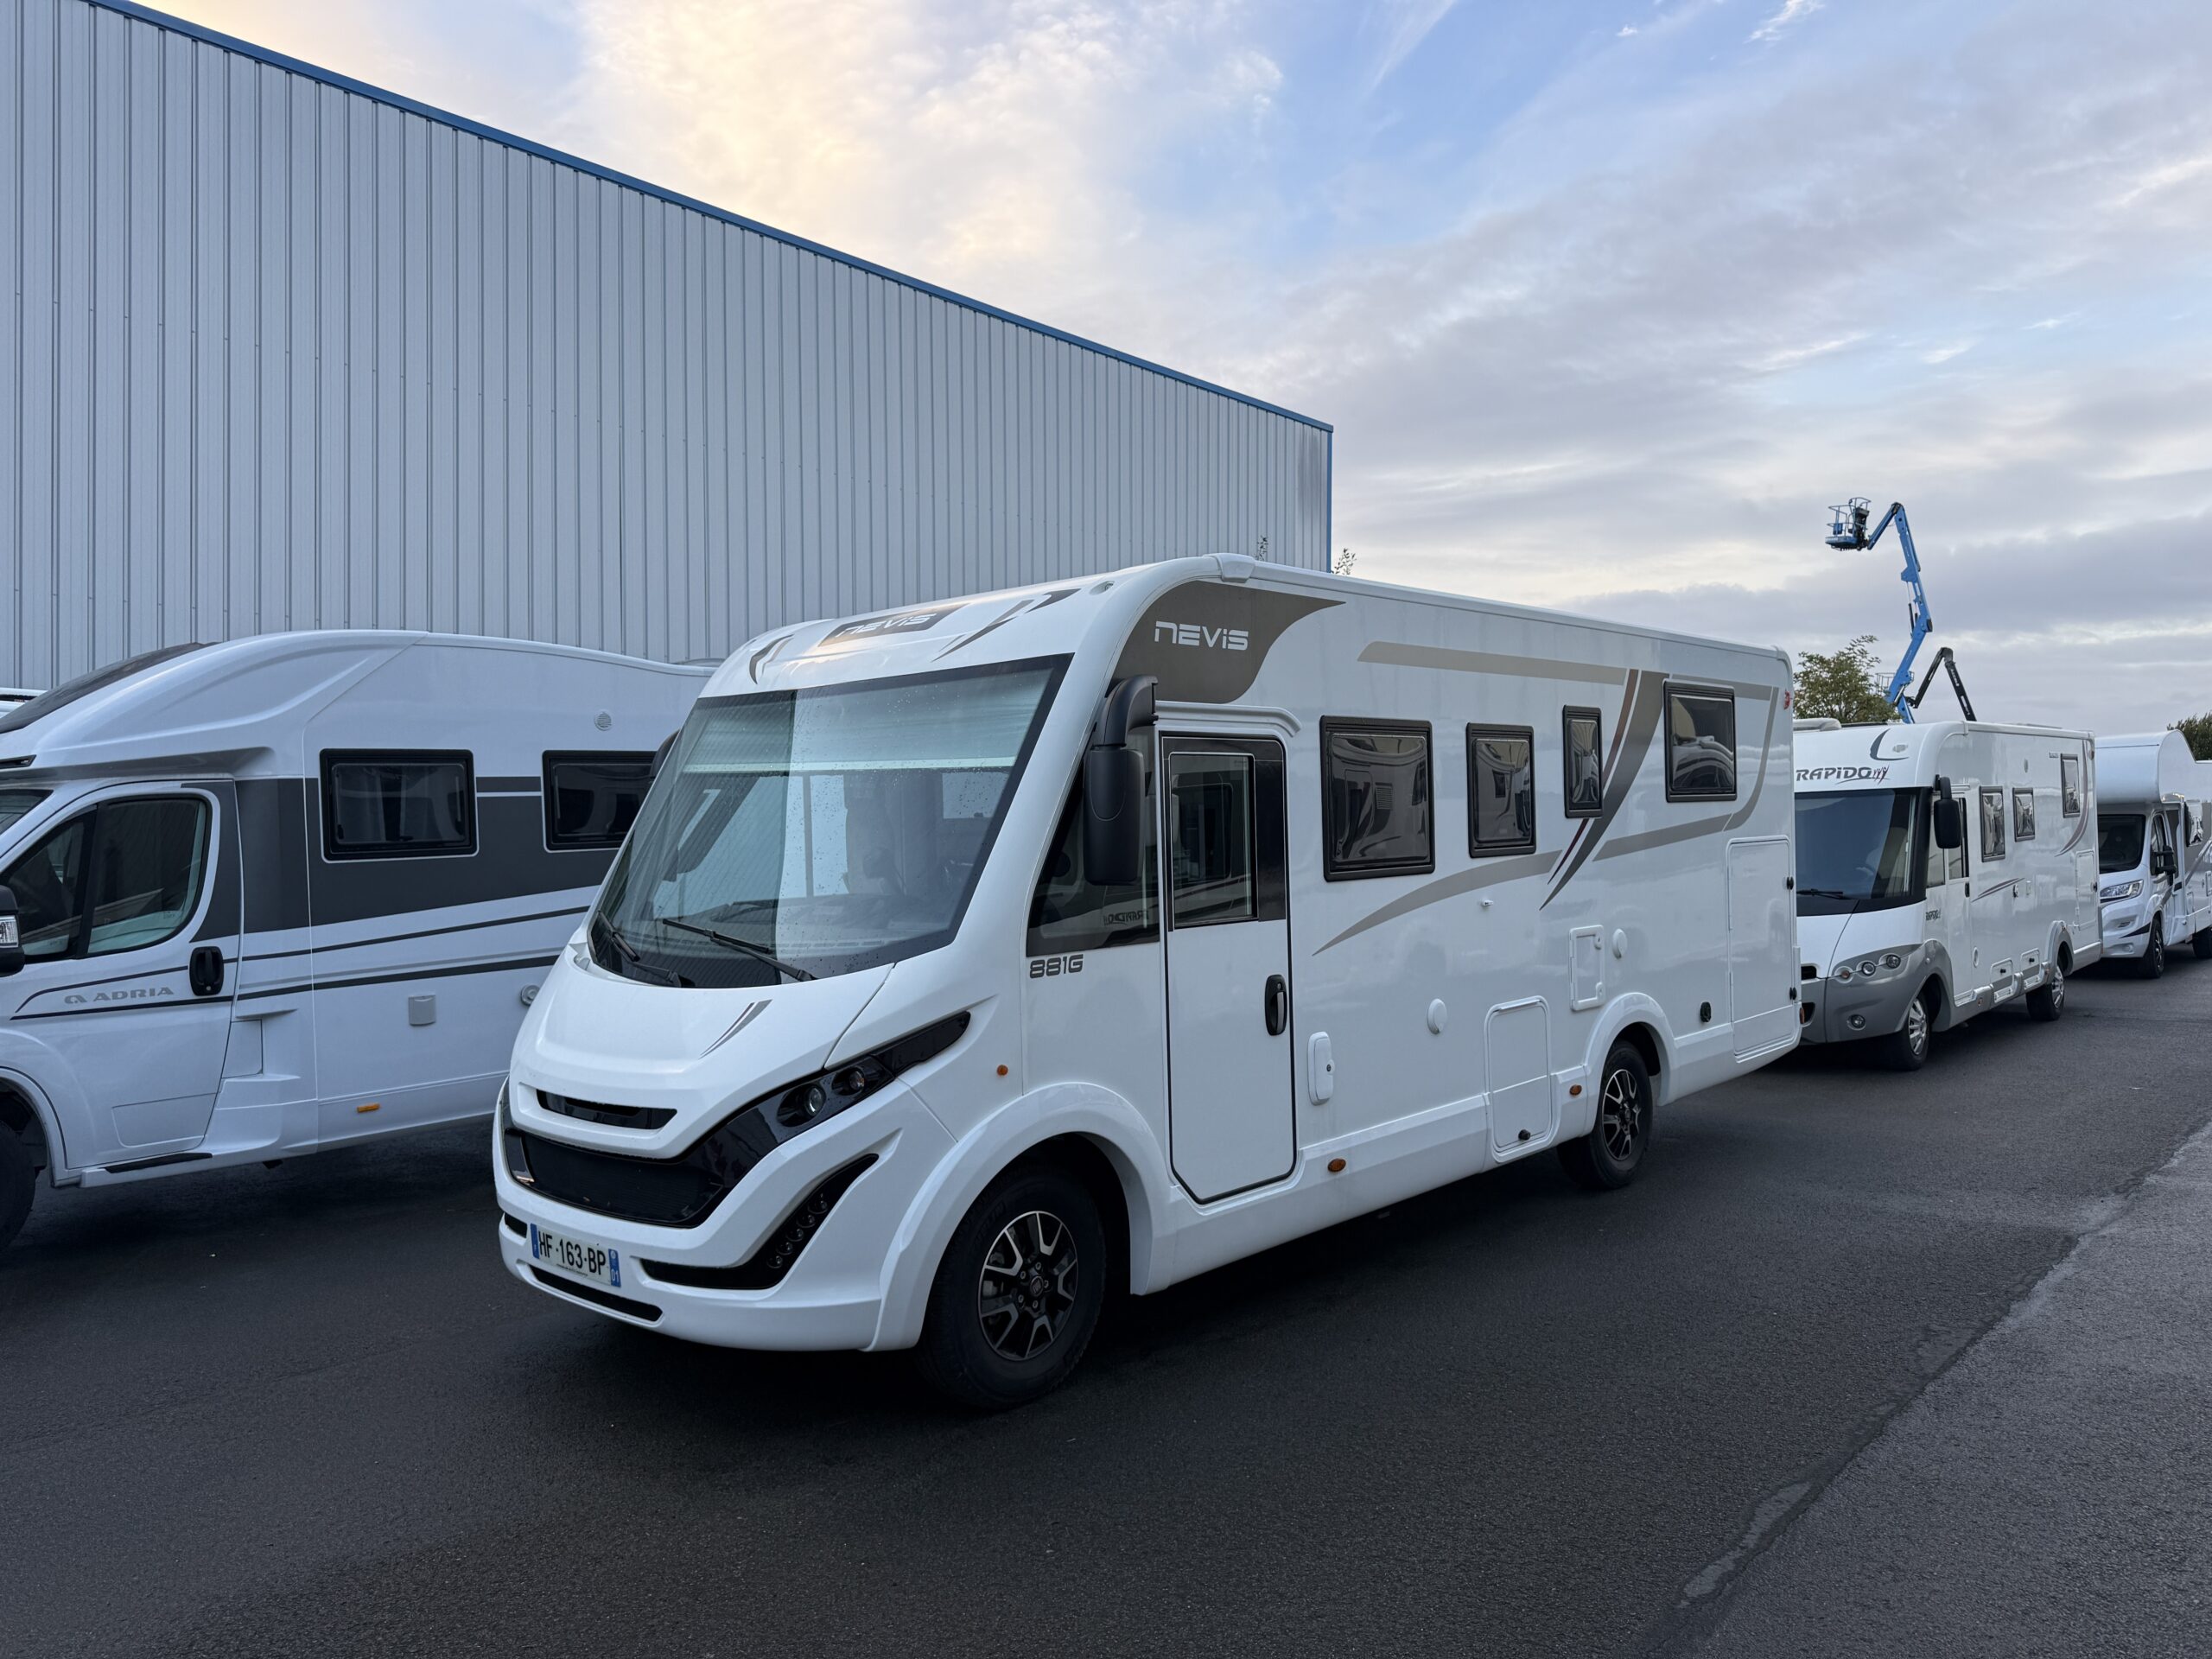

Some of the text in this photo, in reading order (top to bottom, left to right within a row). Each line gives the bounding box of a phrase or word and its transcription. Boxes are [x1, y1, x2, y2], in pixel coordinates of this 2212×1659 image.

[1154, 620, 1249, 651] NEVIS
[1796, 766, 1872, 781] RAPIDO
[1029, 953, 1084, 979] 881G
[93, 987, 175, 1002] ADRIA
